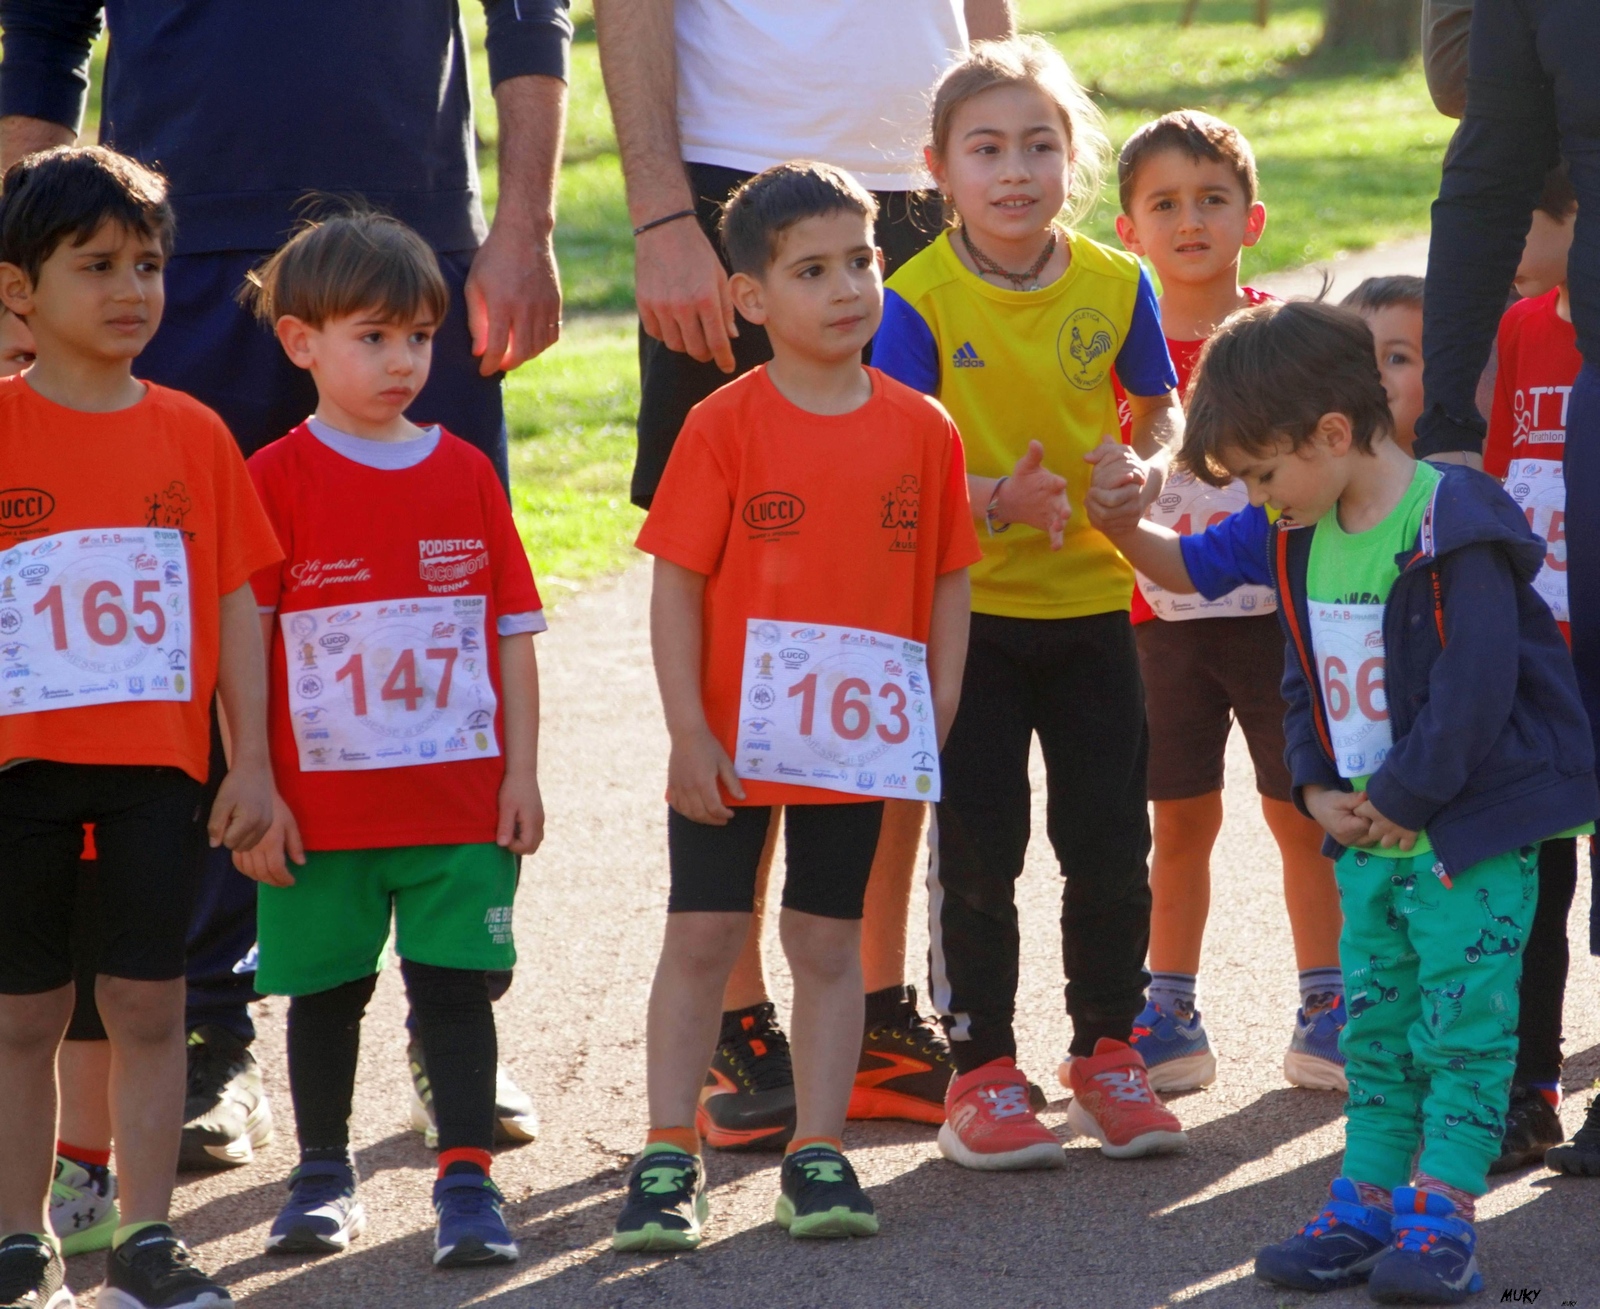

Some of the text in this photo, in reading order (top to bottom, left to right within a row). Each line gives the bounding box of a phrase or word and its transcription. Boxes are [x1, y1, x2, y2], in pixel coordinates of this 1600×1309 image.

[952, 357, 985, 368] adidas
[1530, 432, 1564, 442] Triathlon
[1159, 496, 1179, 504] LUCCI
[750, 501, 793, 522] LUCCI
[419, 539, 484, 559] PODISTICA
[21, 567, 46, 577] LUCCI
[428, 580, 470, 593] RAVENNA
[462, 599, 482, 607] UISP
[33, 579, 166, 652] 165
[321, 636, 347, 646] LUCCI
[780, 652, 807, 661] LUCCI
[335, 646, 458, 717] 147
[1315, 655, 1390, 722] 66
[787, 673, 910, 745] 163
[746, 740, 771, 750] AVIS
